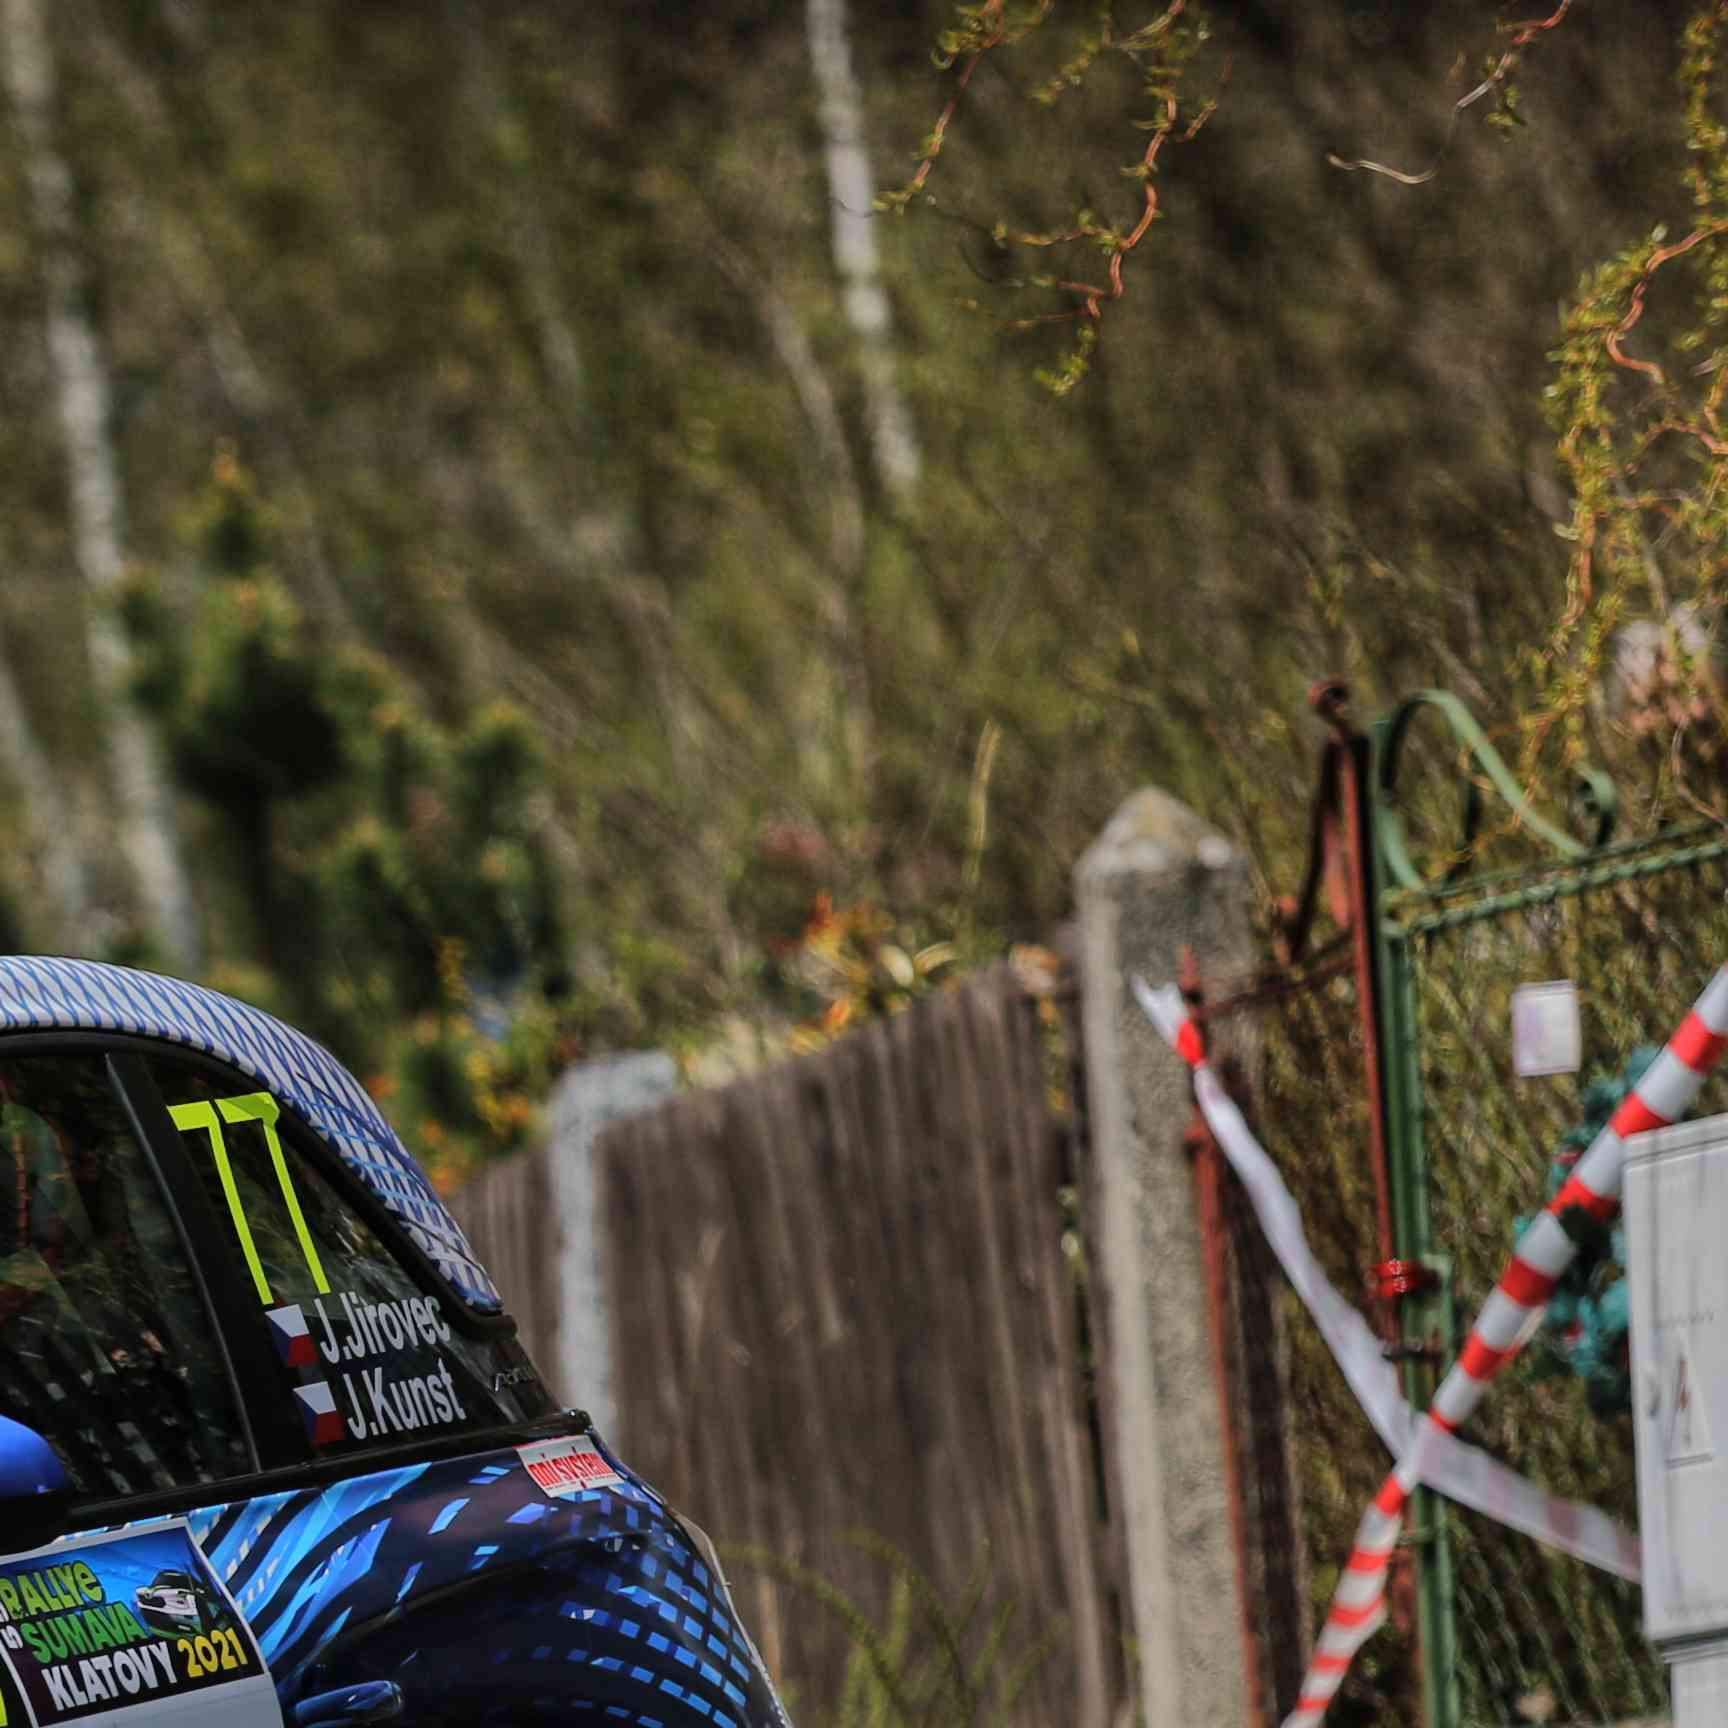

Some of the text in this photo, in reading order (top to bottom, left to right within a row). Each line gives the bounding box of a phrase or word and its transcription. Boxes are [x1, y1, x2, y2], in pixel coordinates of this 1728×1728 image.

[166, 1092, 331, 1304] 77
[343, 1359, 466, 1439] J.Kunst
[42, 1629, 248, 1711] KLATOVY 2021
